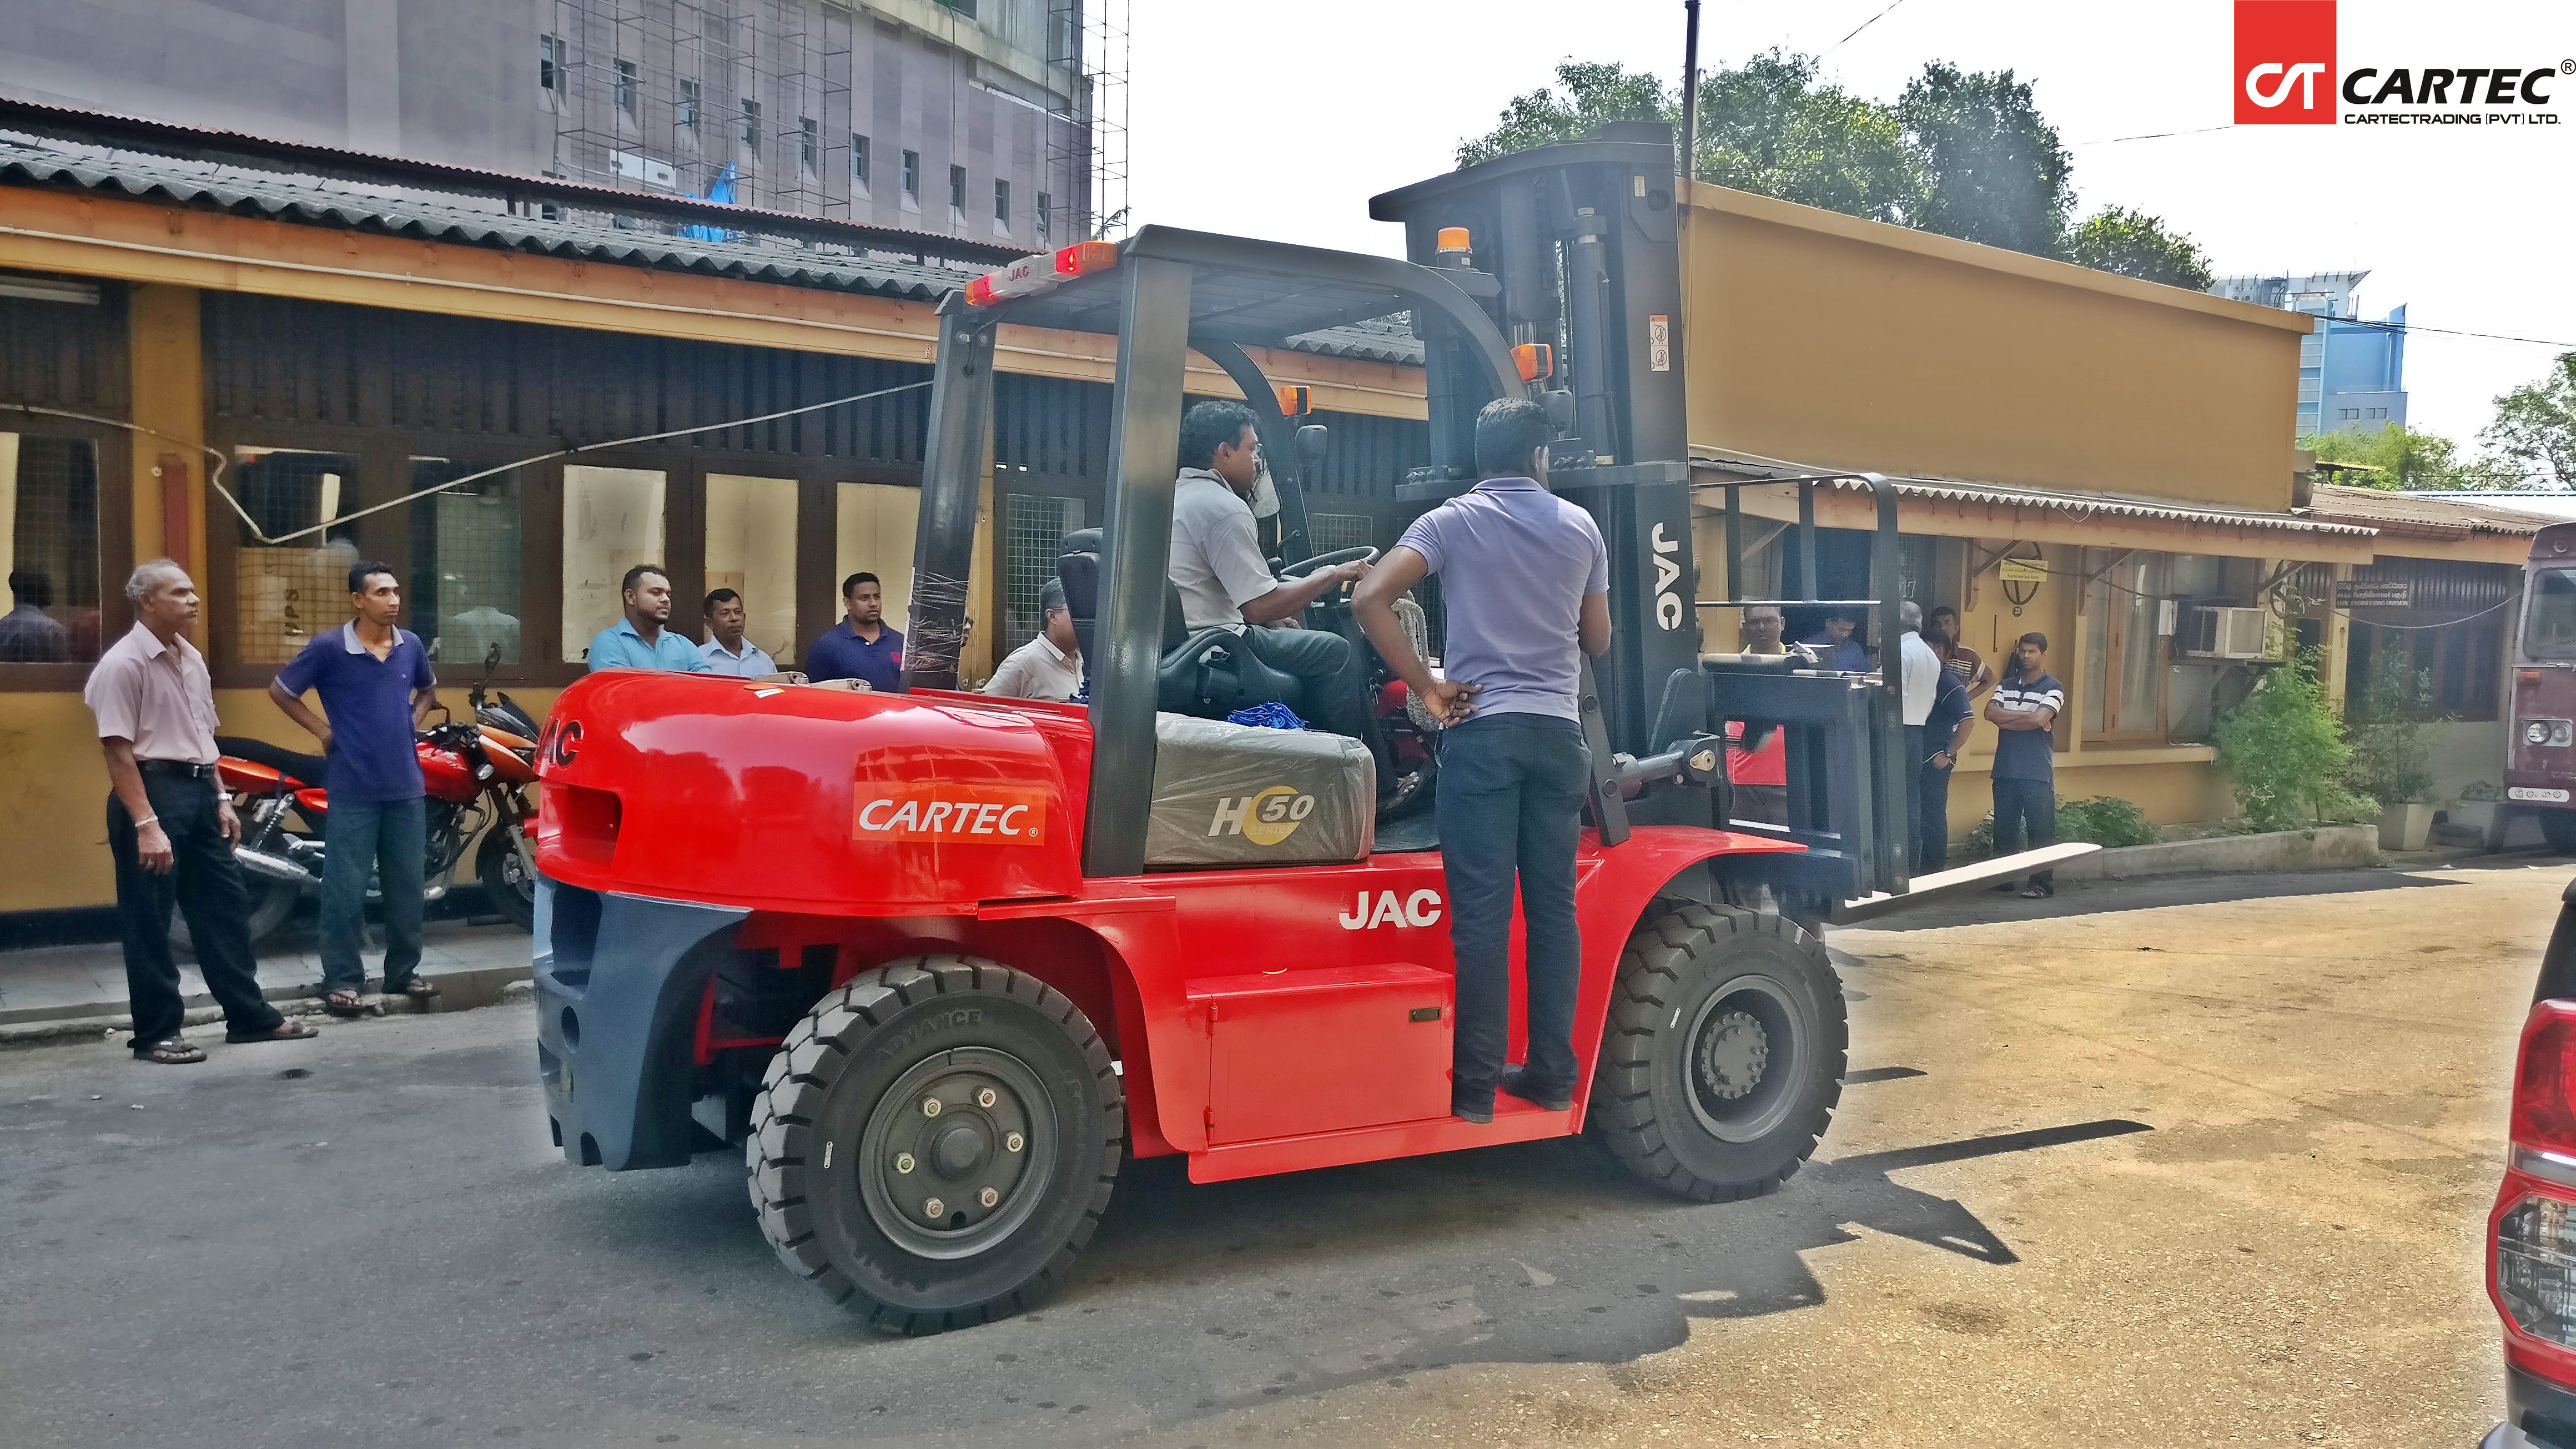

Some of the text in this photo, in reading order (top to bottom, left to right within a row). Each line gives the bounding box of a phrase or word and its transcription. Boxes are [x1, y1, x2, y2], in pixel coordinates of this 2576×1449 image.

[1008, 265, 1029, 281] JAC
[1652, 522, 1682, 631] JAC
[859, 799, 1029, 836] CARTEC
[1339, 889, 1442, 930] JAC
